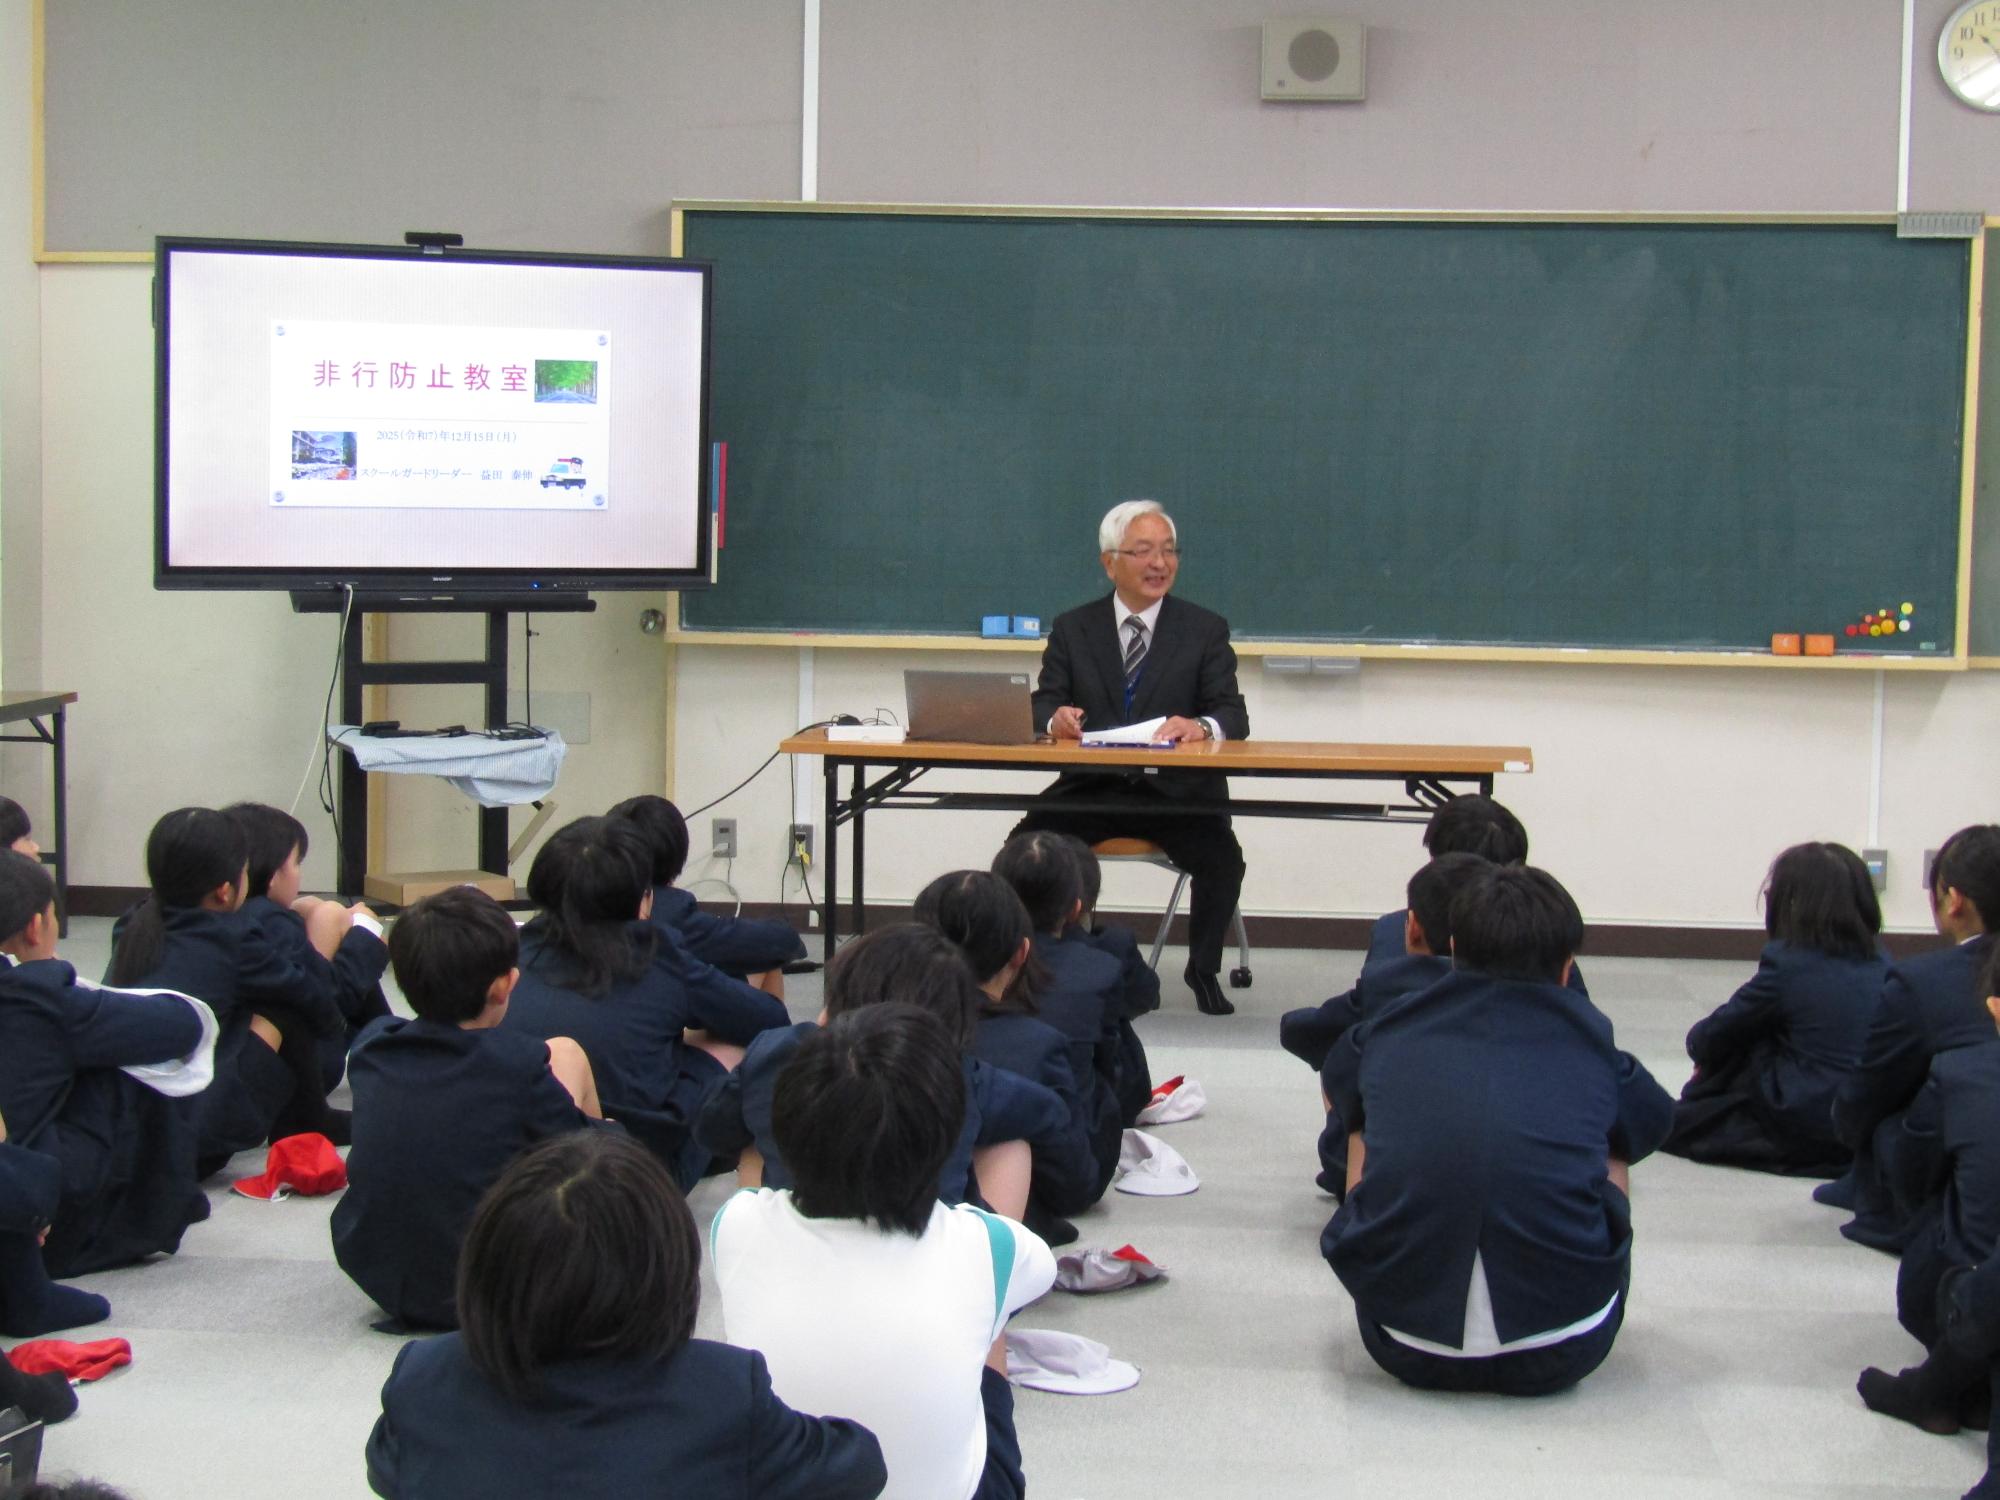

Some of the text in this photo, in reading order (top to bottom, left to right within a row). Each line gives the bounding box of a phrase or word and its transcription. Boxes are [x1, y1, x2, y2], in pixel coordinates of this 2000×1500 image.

[1975, 12, 1985, 26] 11
[1960, 27, 1974, 40] 10
[313, 360, 527, 391] 非行防止教室
[360, 467, 472, 480] スクールガードリーダー
